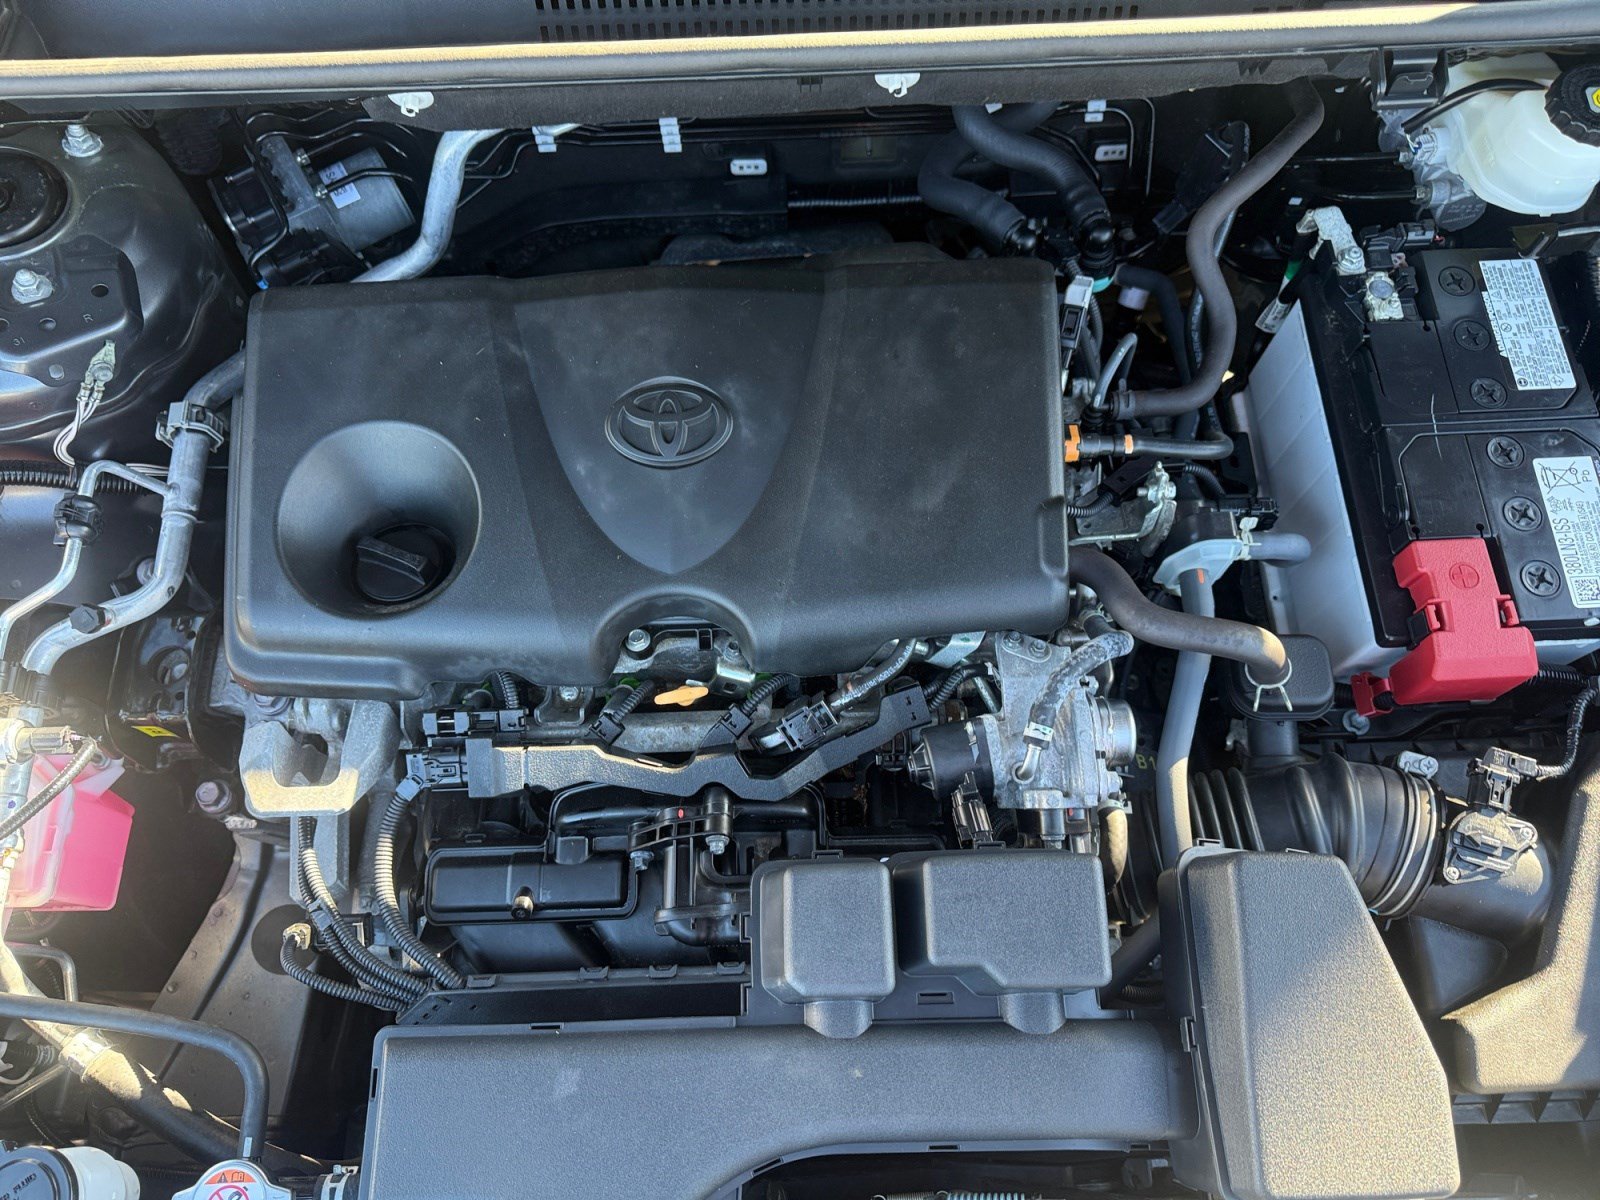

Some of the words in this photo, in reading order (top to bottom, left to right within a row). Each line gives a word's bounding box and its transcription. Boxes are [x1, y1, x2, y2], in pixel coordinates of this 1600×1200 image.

[83, 314, 93, 323] R
[1582, 469, 1592, 482] Pb
[1552, 518, 1583, 574] 380LN3-ISS
[1136, 754, 1157, 770] B1
